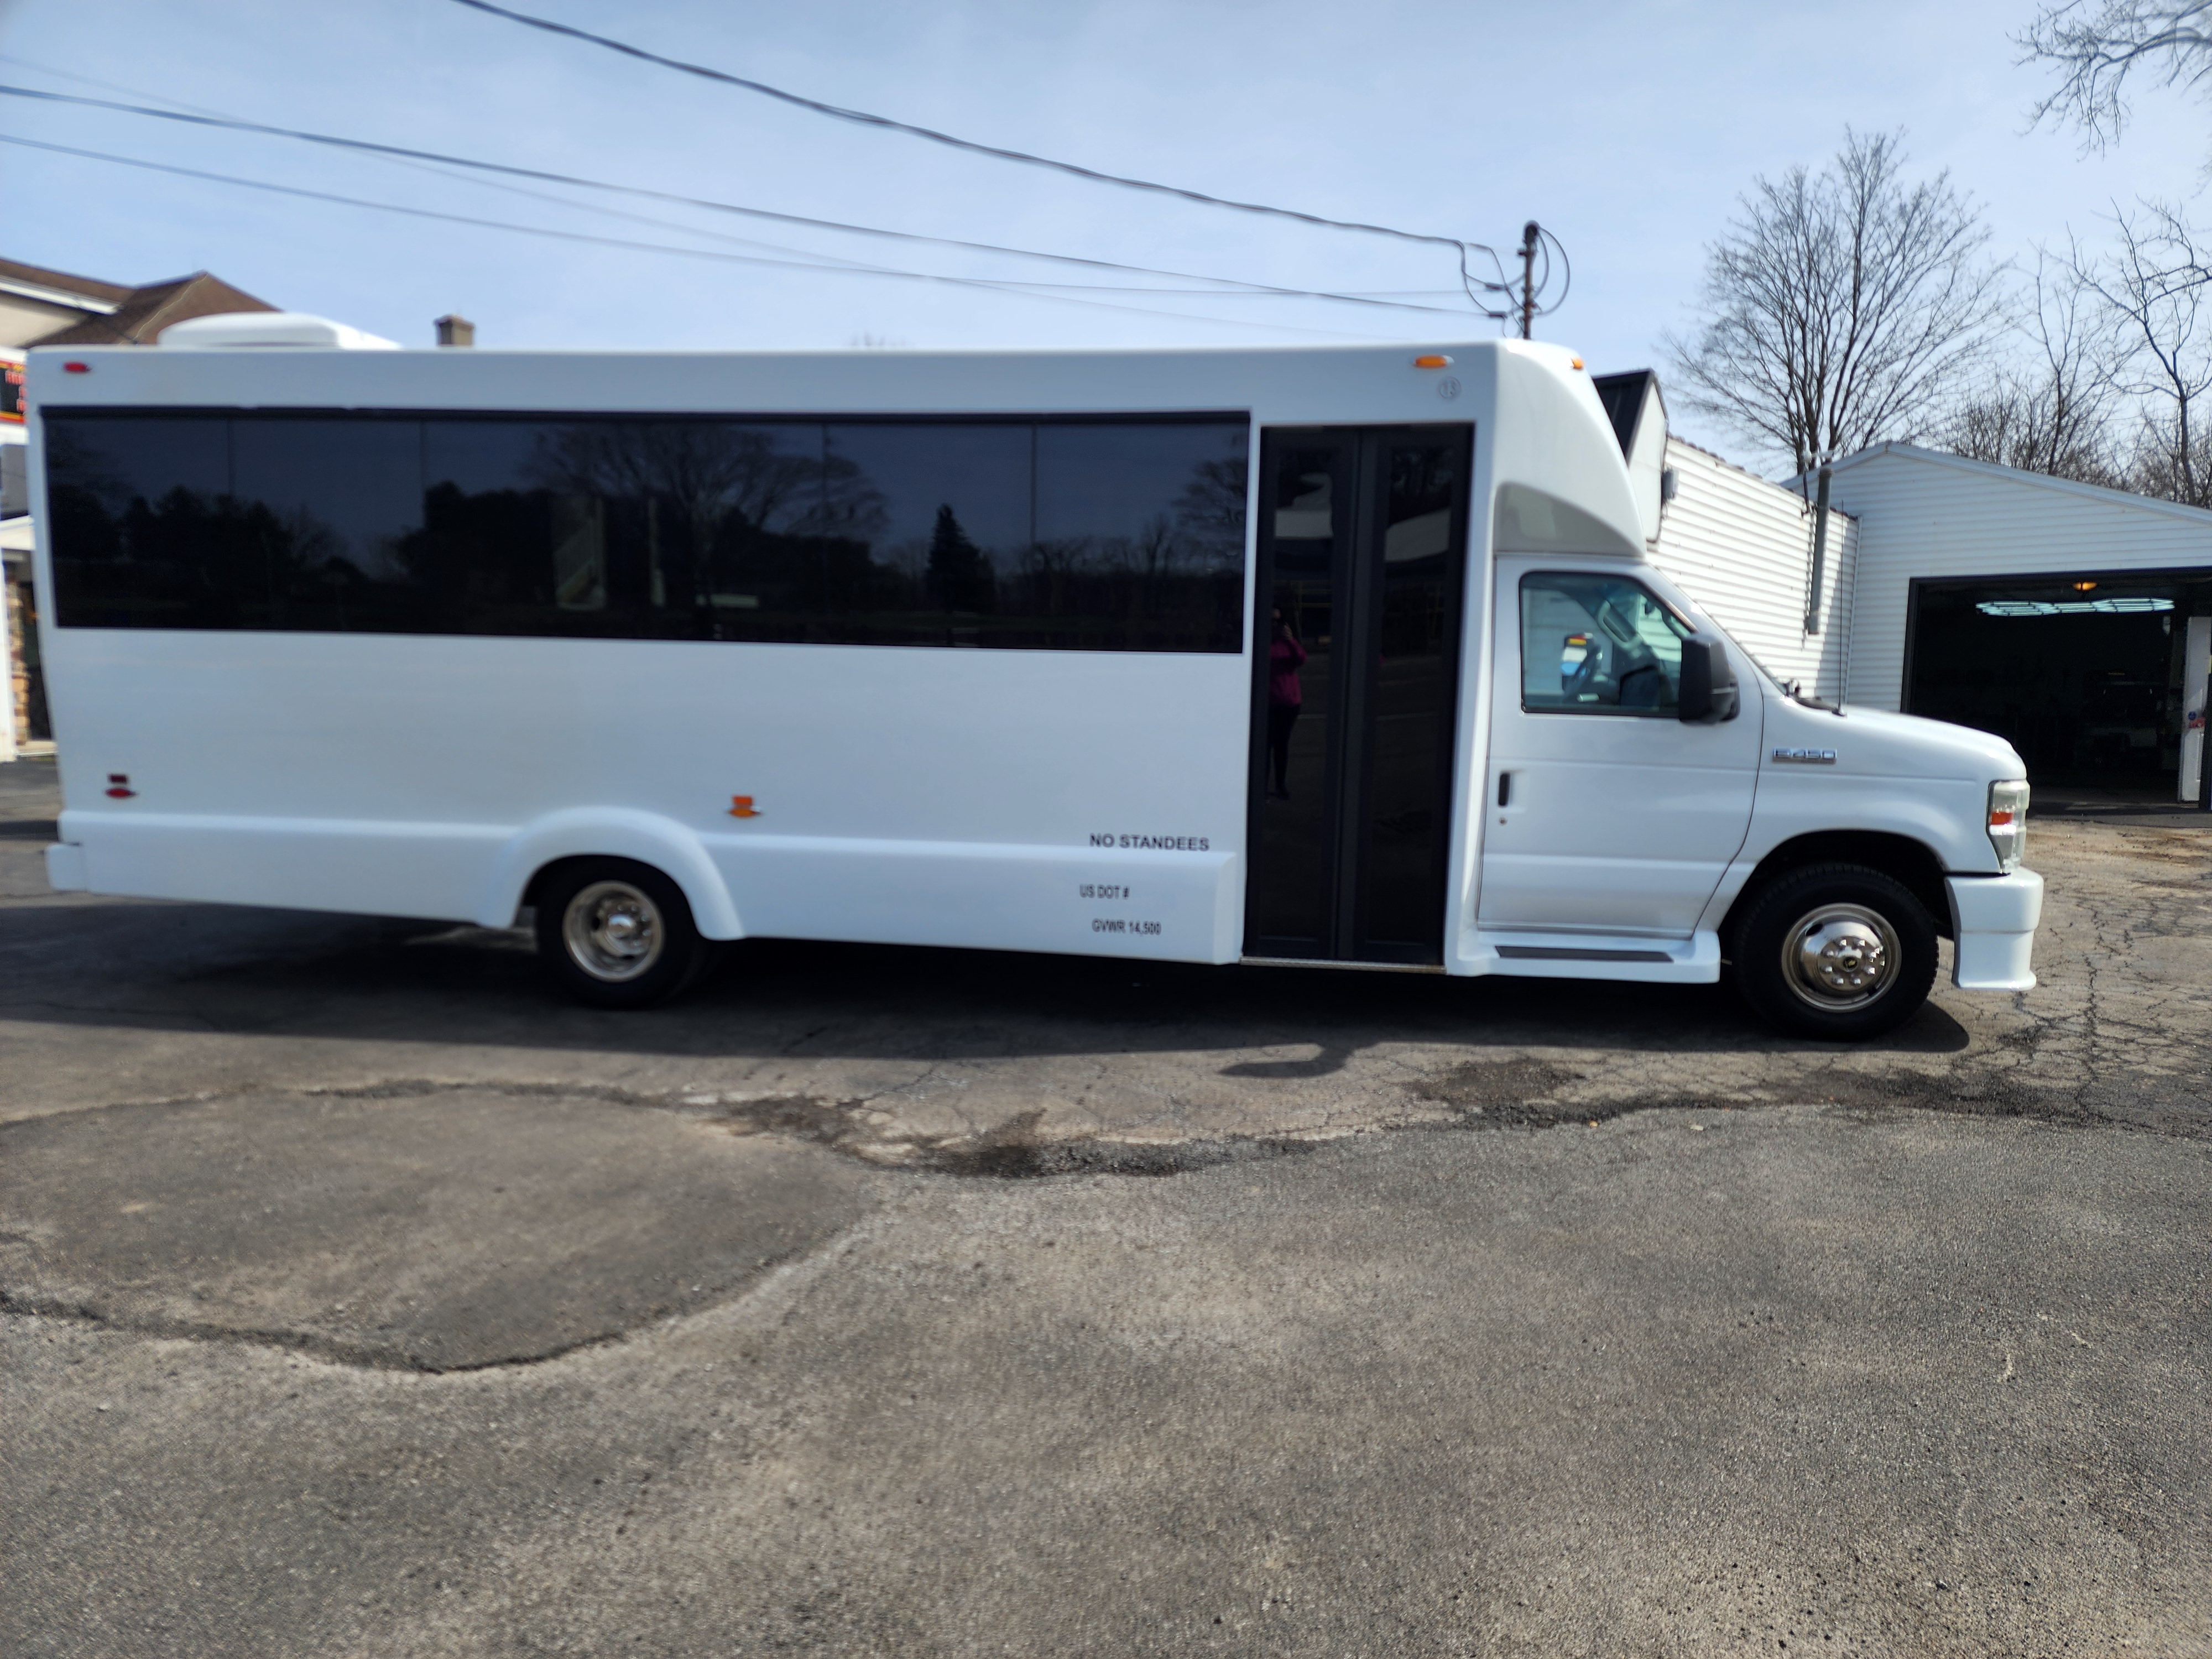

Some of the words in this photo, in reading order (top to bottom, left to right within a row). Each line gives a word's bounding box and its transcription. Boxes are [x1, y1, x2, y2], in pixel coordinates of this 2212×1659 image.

[1090, 833, 1114, 847] NO
[1119, 834, 1209, 851] STANDEES
[1079, 884, 1095, 898] US
[1097, 885, 1120, 899] DOT
[1092, 918, 1126, 933] GVWR
[1129, 920, 1161, 937] 14,500
